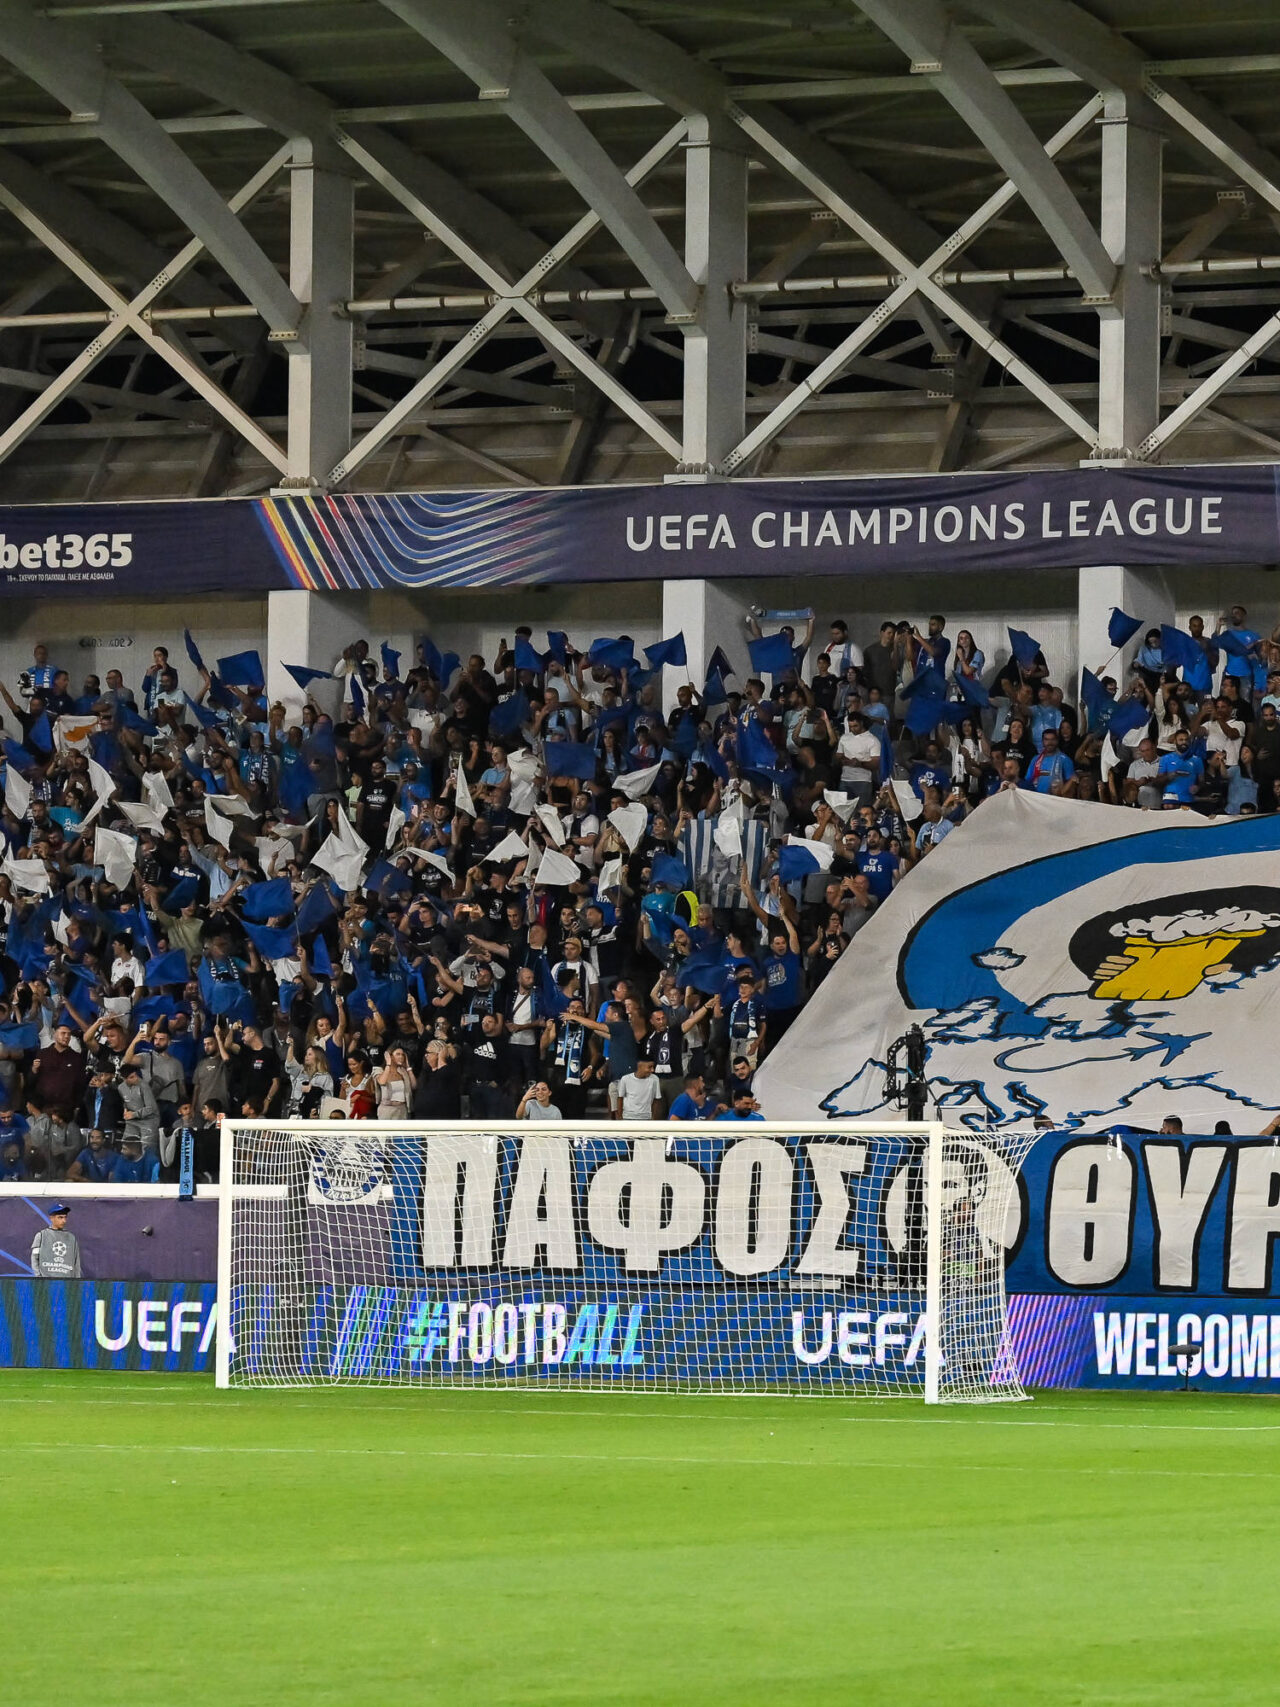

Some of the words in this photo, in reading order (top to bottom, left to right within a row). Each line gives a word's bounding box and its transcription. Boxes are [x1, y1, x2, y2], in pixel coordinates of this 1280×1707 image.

[0, 533, 132, 568] bet365
[626, 513, 736, 552] UEFA
[751, 502, 1026, 549] CHAMPIONS
[1042, 497, 1223, 538] LEAGUE
[473, 1048, 497, 1060] adidas
[424, 1136, 867, 1277] ΠΑΦΟΣ
[407, 1302, 646, 1365] #FOOTBALL
